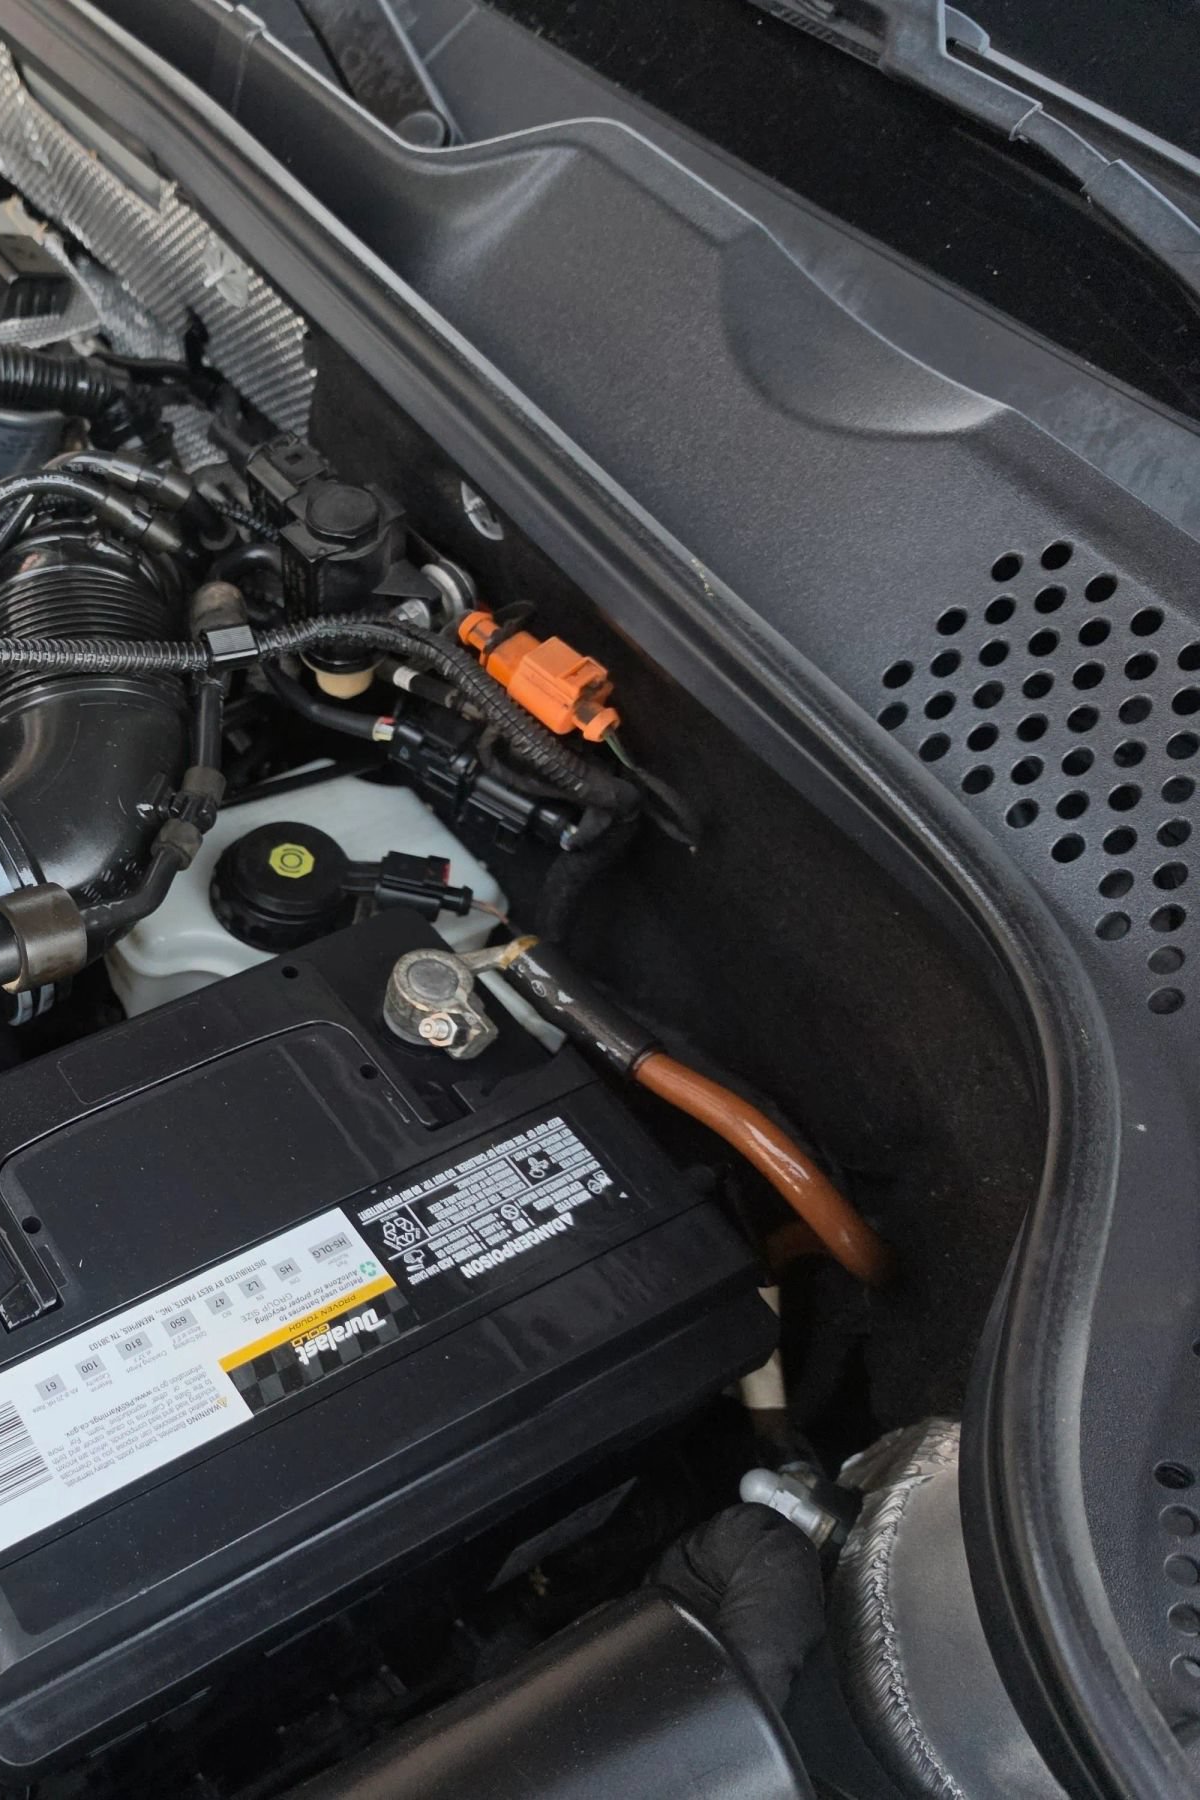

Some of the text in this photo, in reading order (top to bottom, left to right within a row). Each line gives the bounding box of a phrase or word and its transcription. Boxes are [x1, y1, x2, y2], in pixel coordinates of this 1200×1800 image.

[510, 1216, 529, 1233] NO
[310, 1236, 346, 1258] H5-DLG
[459, 1216, 568, 1281] DANGER/POISON
[222, 1257, 267, 1284] DISTRIBUTED
[278, 1263, 293, 1275] H5
[195, 1283, 214, 1297] BEST
[212, 1278, 224, 1289] BY
[245, 1280, 259, 1291] L2
[171, 1292, 196, 1309] PARTS,
[212, 1296, 225, 1307] 47
[253, 1268, 358, 1325] AutoZone for proper recycling
[278, 1275, 363, 1323] Return used batteries to
[239, 1291, 293, 1322] GROUP SIZE
[287, 1293, 356, 1332] PROVEN TOUGH
[119, 1312, 155, 1335] MEMPHIS,
[169, 1315, 187, 1329] 650
[87, 1334, 110, 1351] 38103
[108, 1330, 119, 1340] TN
[289, 1322, 330, 1347] GOLD
[292, 1305, 387, 1367] Duralast
[124, 1337, 142, 1351] 810
[79, 1359, 98, 1373] 100
[44, 1381, 57, 1392] 61
[185, 1402, 221, 1425] WARNING
[115, 1435, 139, 1451] expose
[101, 1448, 114, 1459] you
